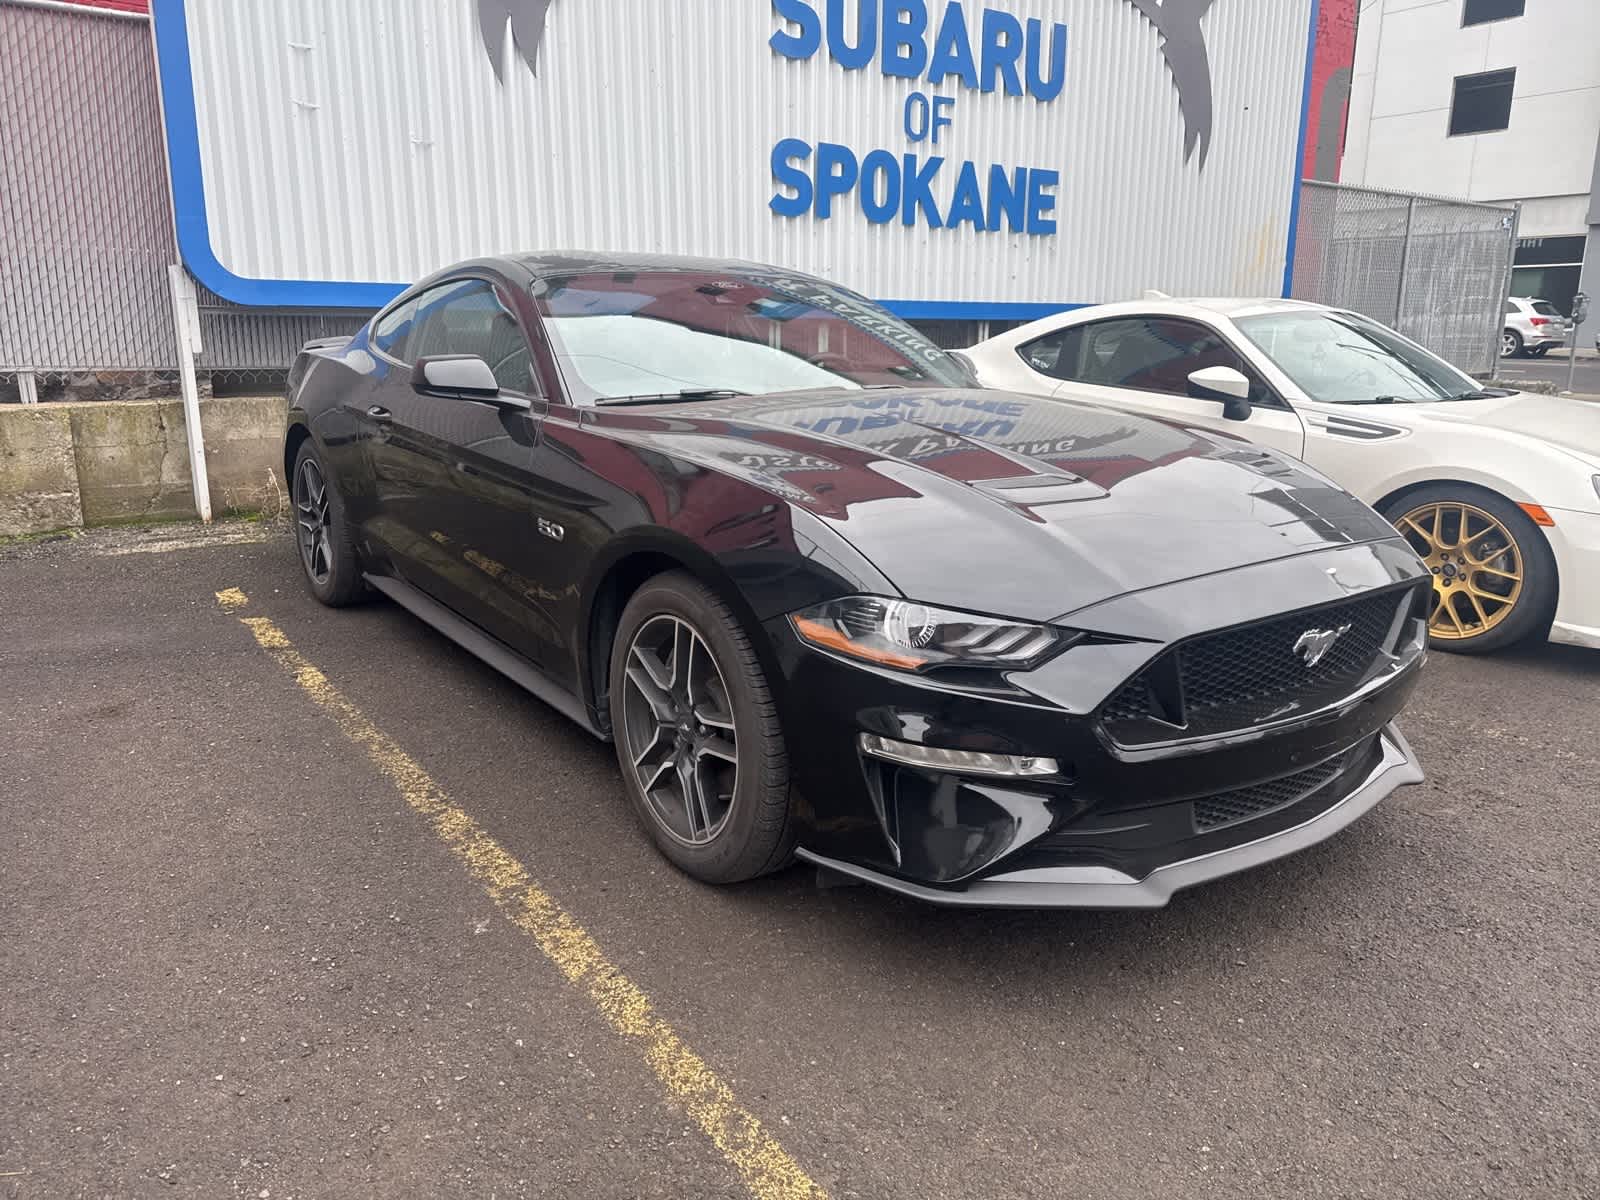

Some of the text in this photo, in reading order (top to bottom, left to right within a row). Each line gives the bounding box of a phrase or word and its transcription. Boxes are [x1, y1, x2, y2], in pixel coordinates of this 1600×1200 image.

[769, 0, 1067, 102] SUBARU
[904, 91, 955, 144] OF
[769, 138, 1059, 234] SPOKANE
